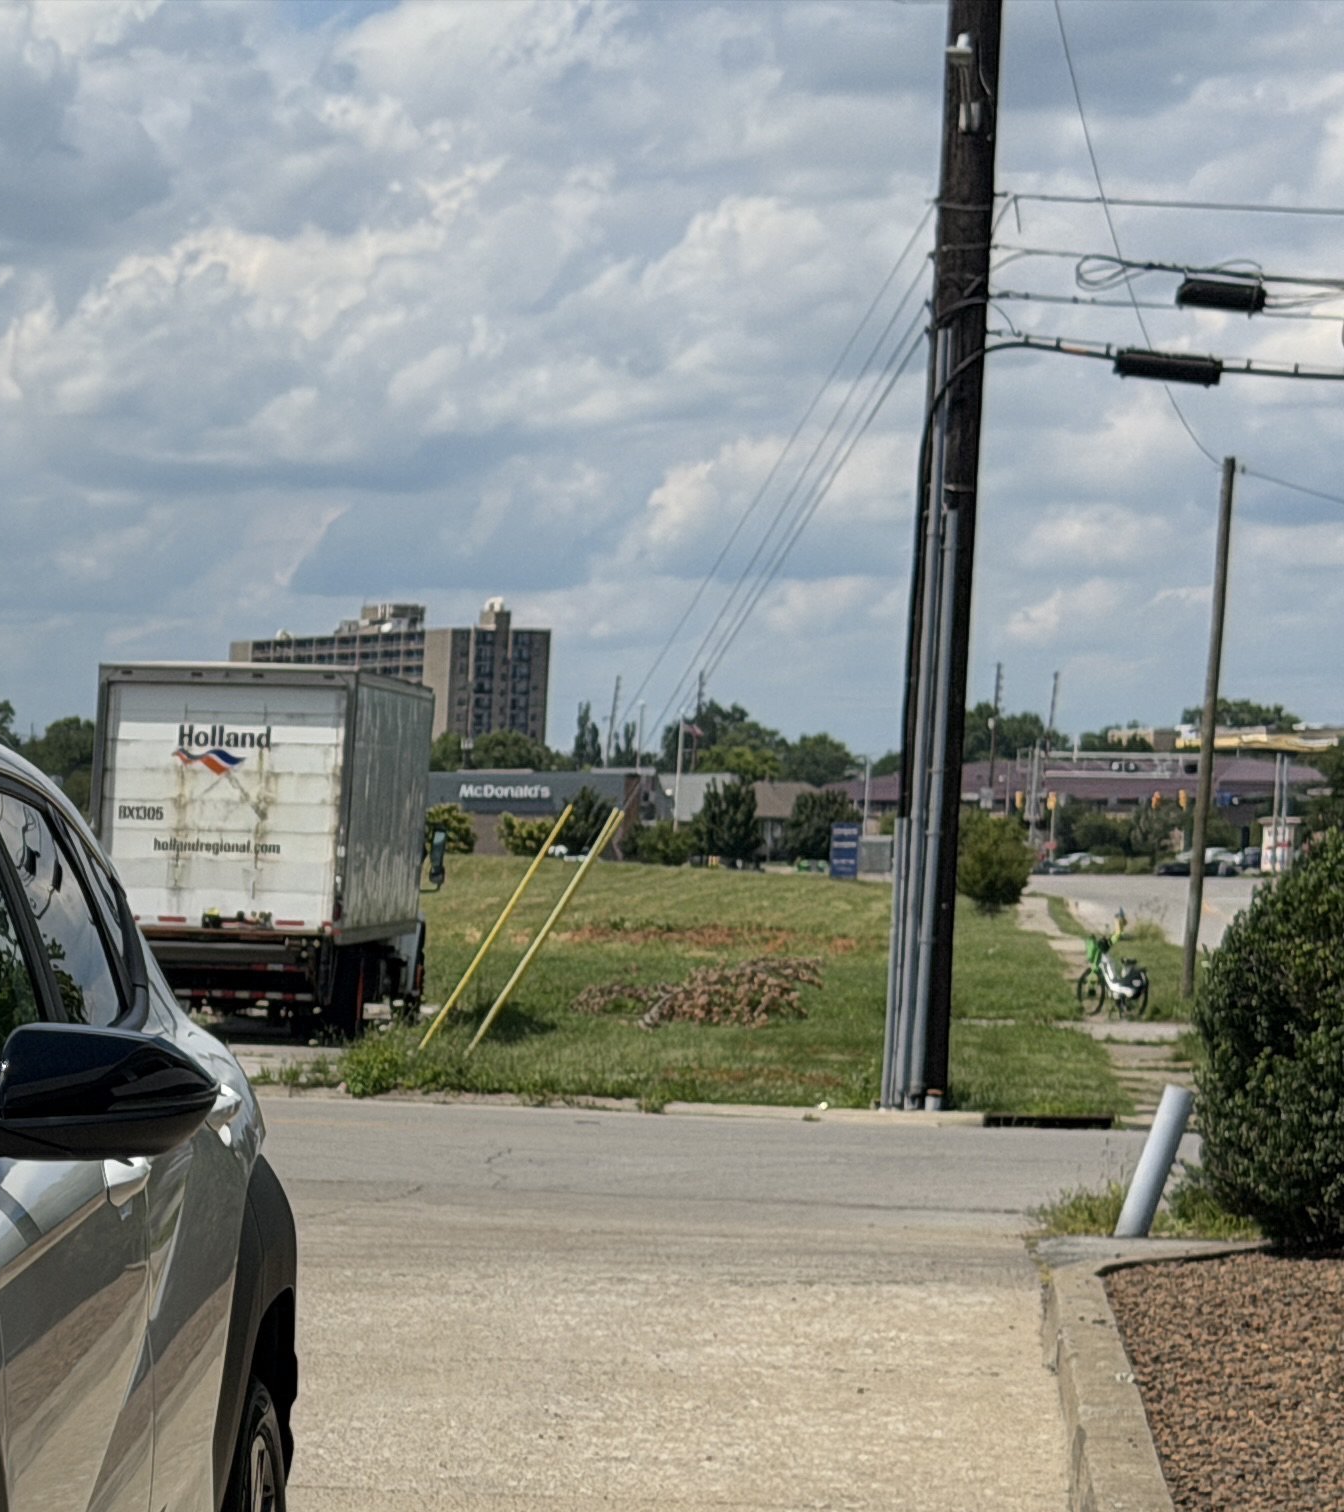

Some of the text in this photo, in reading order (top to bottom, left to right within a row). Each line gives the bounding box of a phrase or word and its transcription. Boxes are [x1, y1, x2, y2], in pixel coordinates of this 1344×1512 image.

[178, 724, 271, 749] Holland
[458, 783, 551, 799] McDonald's
[153, 837, 281, 856] hollandregional.com
